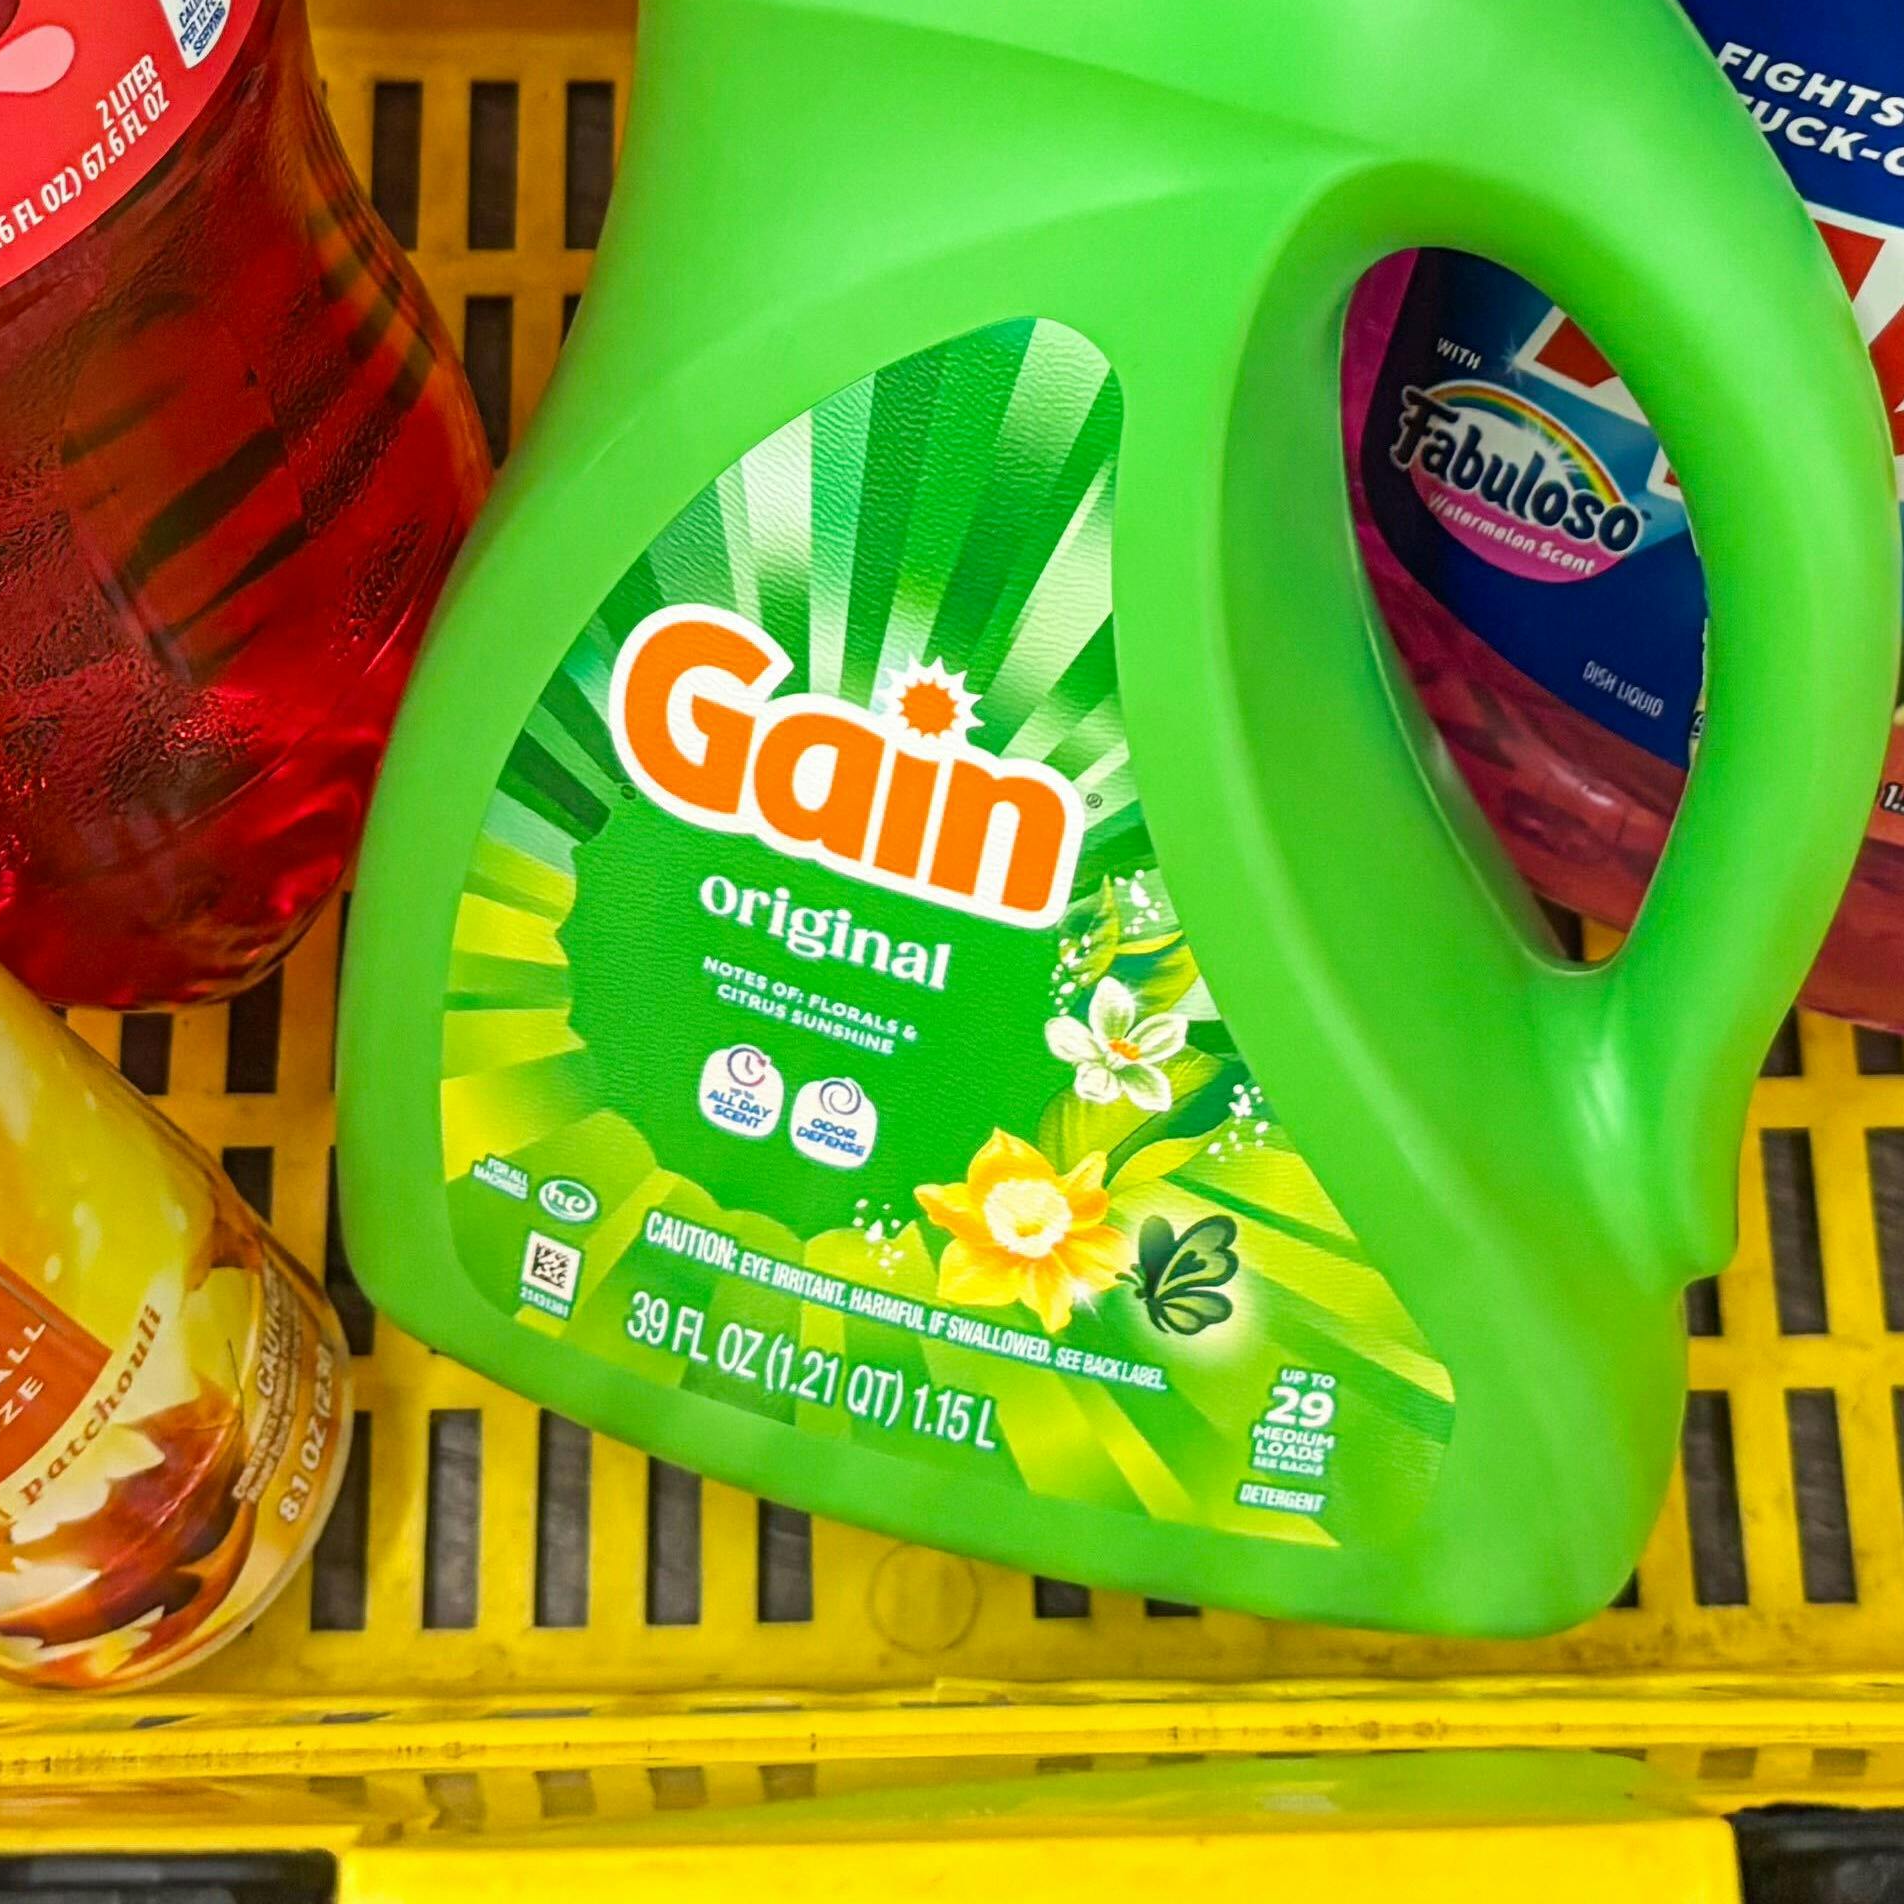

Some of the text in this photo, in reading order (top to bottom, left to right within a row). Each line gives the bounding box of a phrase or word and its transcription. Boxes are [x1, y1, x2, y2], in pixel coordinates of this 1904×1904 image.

[96, 53, 159, 131] 2 LITER
[13, 201, 45, 239] FL
[39, 162, 86, 215] OZ)
[81, 126, 127, 183] 67.6
[121, 109, 148, 146] FL
[142, 80, 171, 123] OZ
[1435, 337, 1483, 372] WITH
[1391, 386, 1642, 553] Fabuloso
[1537, 537, 1596, 576] Scent
[1582, 659, 1665, 719] DISH LIQUID
[615, 609, 1077, 922] Gain
[701, 955, 769, 991] NOTES
[807, 993, 900, 1036] FLORALS
[901, 1023, 919, 1042] &
[716, 983, 896, 1055] CITRUS SUNSHINE
[706, 1089, 774, 1119] ALL DAY
[712, 1104, 763, 1129] SCENT
[810, 1117, 859, 1141] ODOR
[795, 1126, 866, 1158] DEFENSE
[645, 1210, 1122, 1384] CAUTION: EYE IRRITANT. HARMFUL IF SWALLOWED. SEE BACK
[626, 1290, 670, 1342] 39
[671, 1306, 709, 1363] FL
[717, 1322, 761, 1380] OZ
[764, 1331, 840, 1408] (1.21
[846, 1362, 905, 1428] QT)
[912, 1383, 975, 1445] 1.15
[974, 1395, 998, 1452] L
[1281, 1368, 1337, 1390] UP TO
[19, 1303, 164, 1507] patchouli
[1264, 1385, 1336, 1428] 29
[300, 1414, 328, 1474] OZ
[1252, 1424, 1336, 1450] MEDIUM
[1255, 1439, 1325, 1463] LOADS
[1239, 1482, 1326, 1512] DETERGENT
